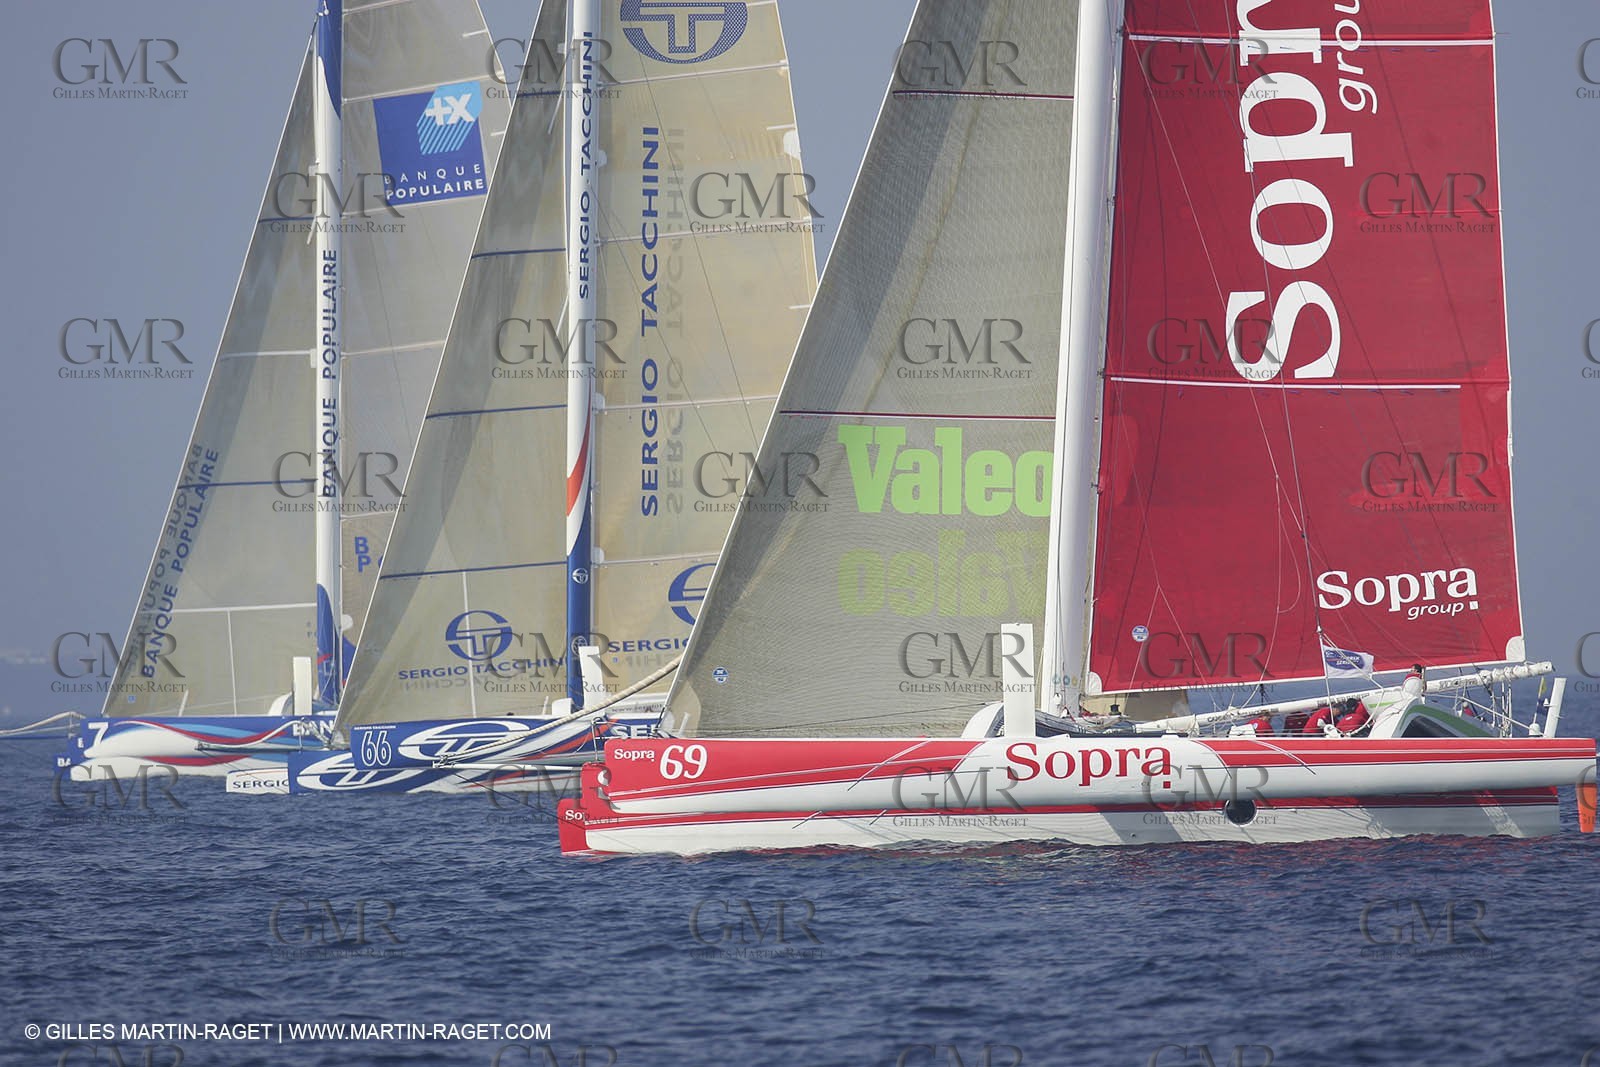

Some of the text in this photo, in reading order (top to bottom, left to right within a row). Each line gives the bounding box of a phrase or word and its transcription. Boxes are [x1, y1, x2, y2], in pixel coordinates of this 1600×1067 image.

[384, 164, 481, 185] BANQUE
[579, 31, 592, 300] SERGIO TACCHINI
[386, 179, 484, 200] POPULAIRE
[641, 127, 659, 517] SERGIO TACCHINI
[322, 249, 338, 498] BANQUE POPULAIRE
[838, 424, 1053, 517] Valeo
[141, 449, 219, 678] BANQUE POPULAIRE
[1316, 567, 1478, 613] Sopra
[1407, 600, 1465, 620] group
[398, 666, 468, 680] SERGIO
[84, 721, 109, 758] 7
[362, 730, 392, 766] 66
[614, 748, 655, 761] Sopra
[659, 744, 708, 780] 69
[1006, 742, 1172, 789] Sopra
